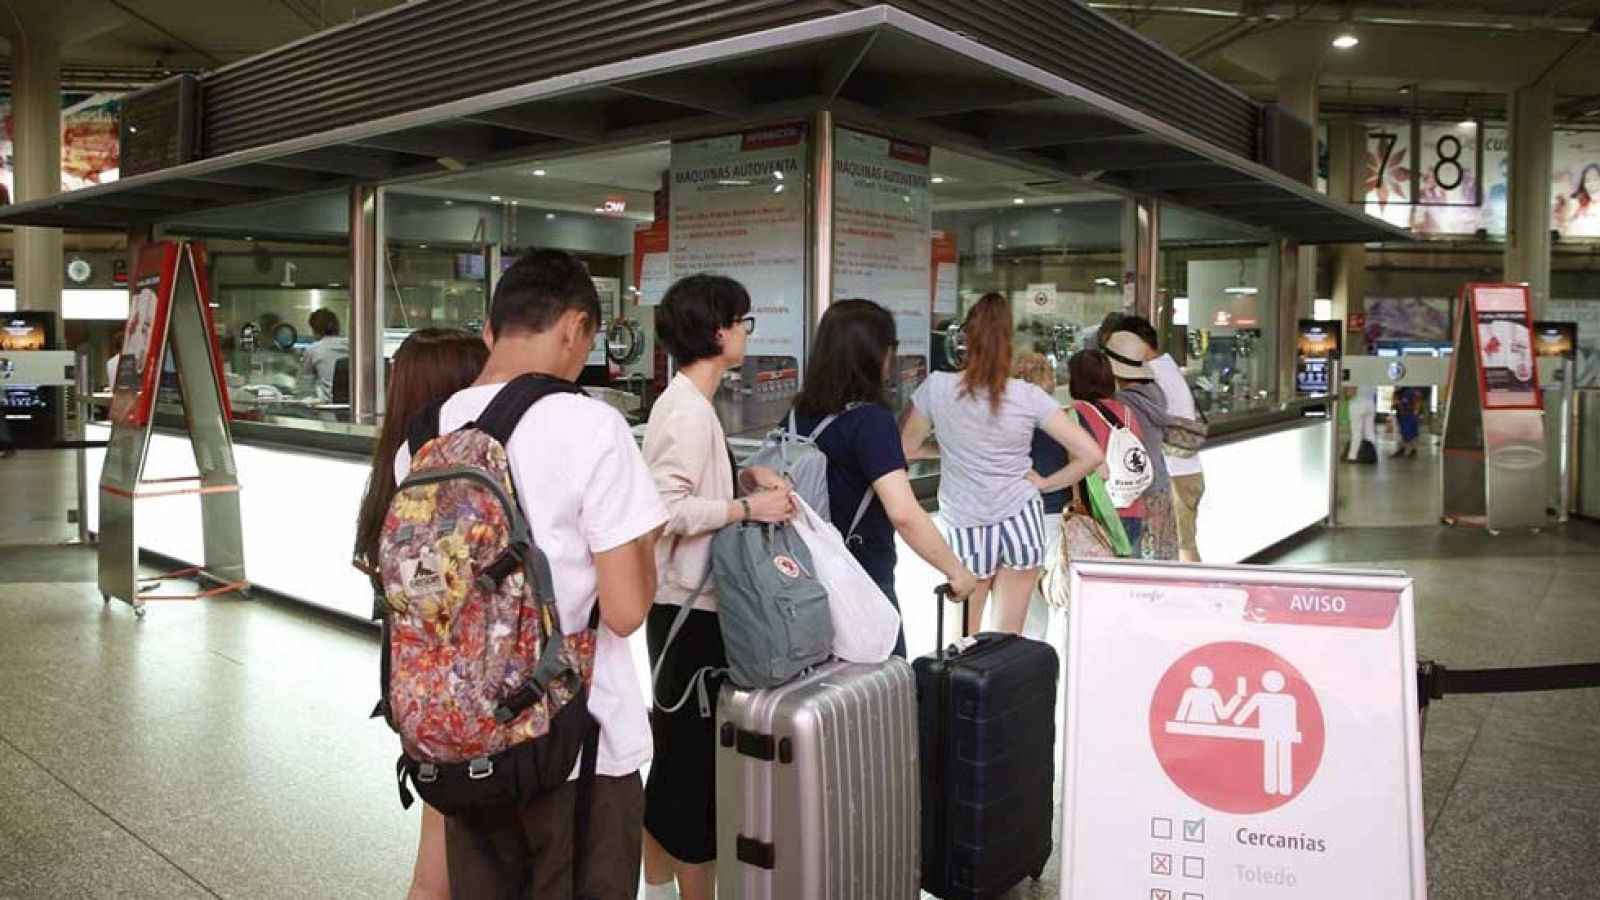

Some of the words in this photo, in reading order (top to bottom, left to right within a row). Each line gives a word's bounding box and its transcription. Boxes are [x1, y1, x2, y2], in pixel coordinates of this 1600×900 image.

[1368, 133, 1397, 188] 7
[1434, 134, 1463, 190] 8
[1290, 594, 1347, 612] AVISO
[1236, 863, 1297, 888] Toledo
